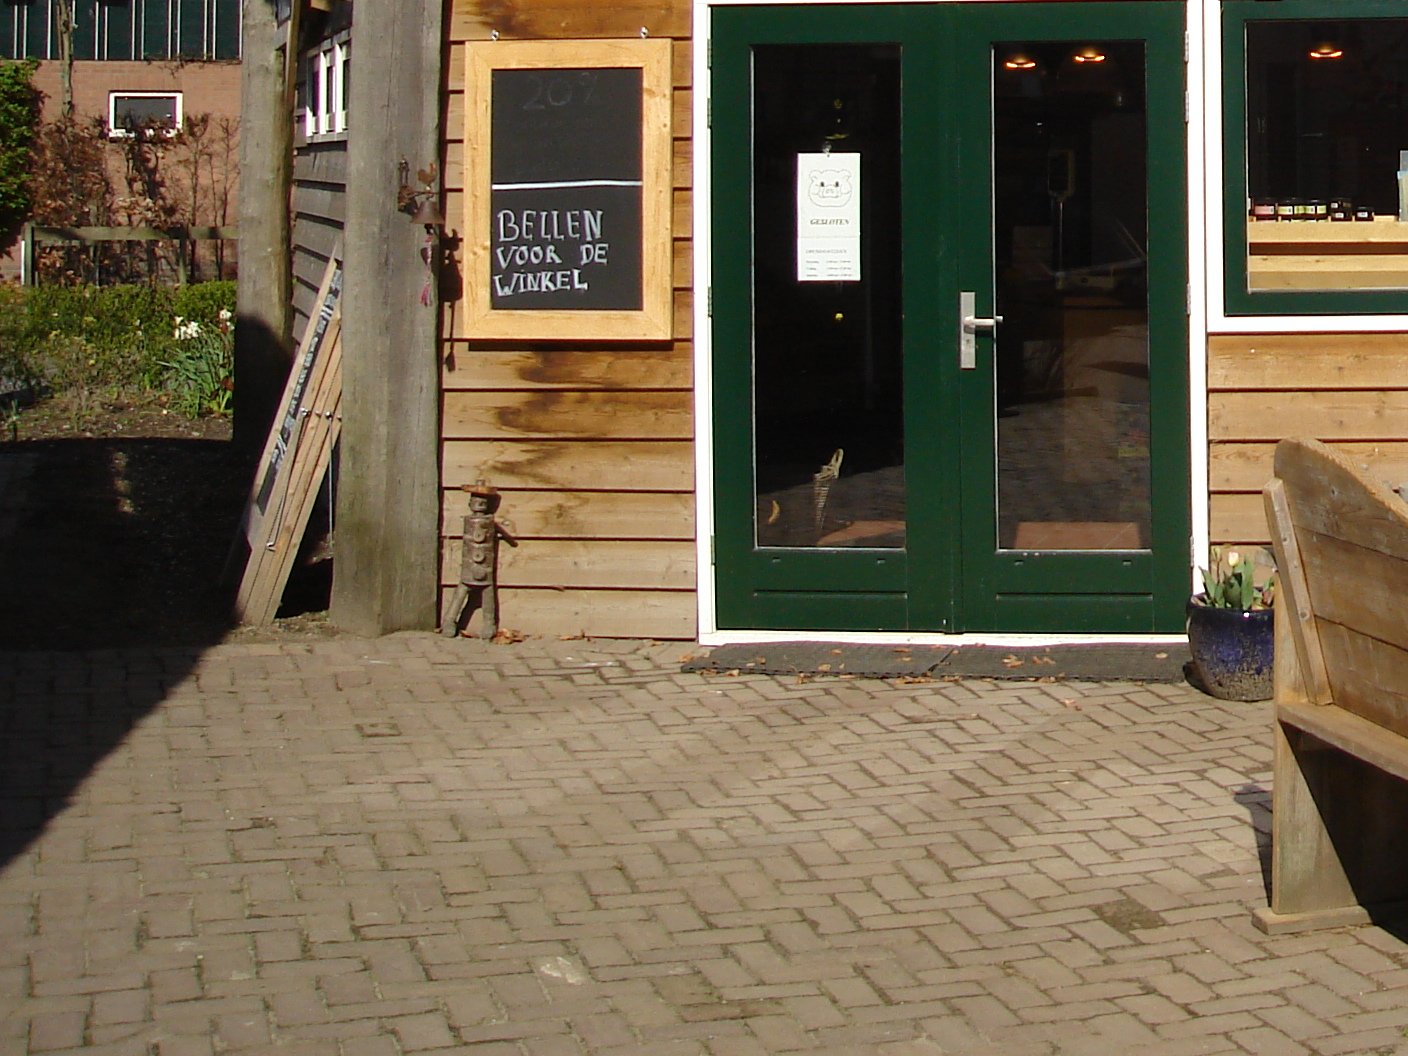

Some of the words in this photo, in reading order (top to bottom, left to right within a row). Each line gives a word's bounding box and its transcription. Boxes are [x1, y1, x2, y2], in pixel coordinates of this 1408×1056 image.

[497, 210, 604, 241] BELLEN
[496, 245, 563, 269] VOOR
[580, 243, 609, 265] DE
[493, 269, 589, 296] WINKEL
